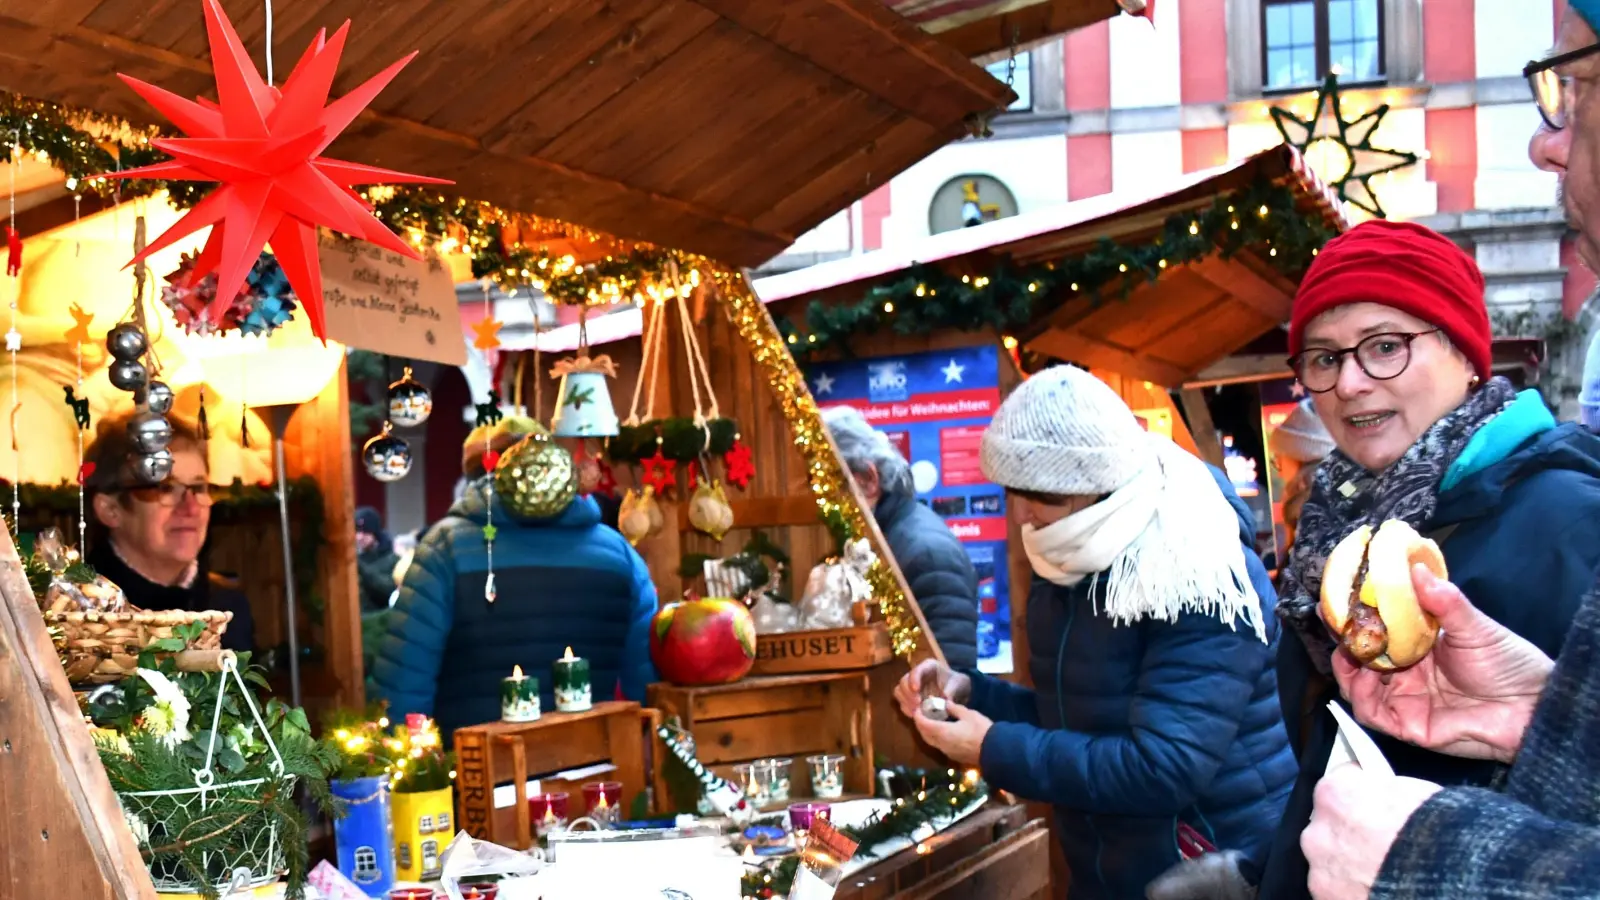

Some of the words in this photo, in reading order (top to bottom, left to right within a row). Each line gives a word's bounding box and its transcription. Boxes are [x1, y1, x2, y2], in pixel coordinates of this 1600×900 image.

[323, 288, 347, 307] roße
[862, 404, 891, 419] idee
[891, 403, 909, 418] für
